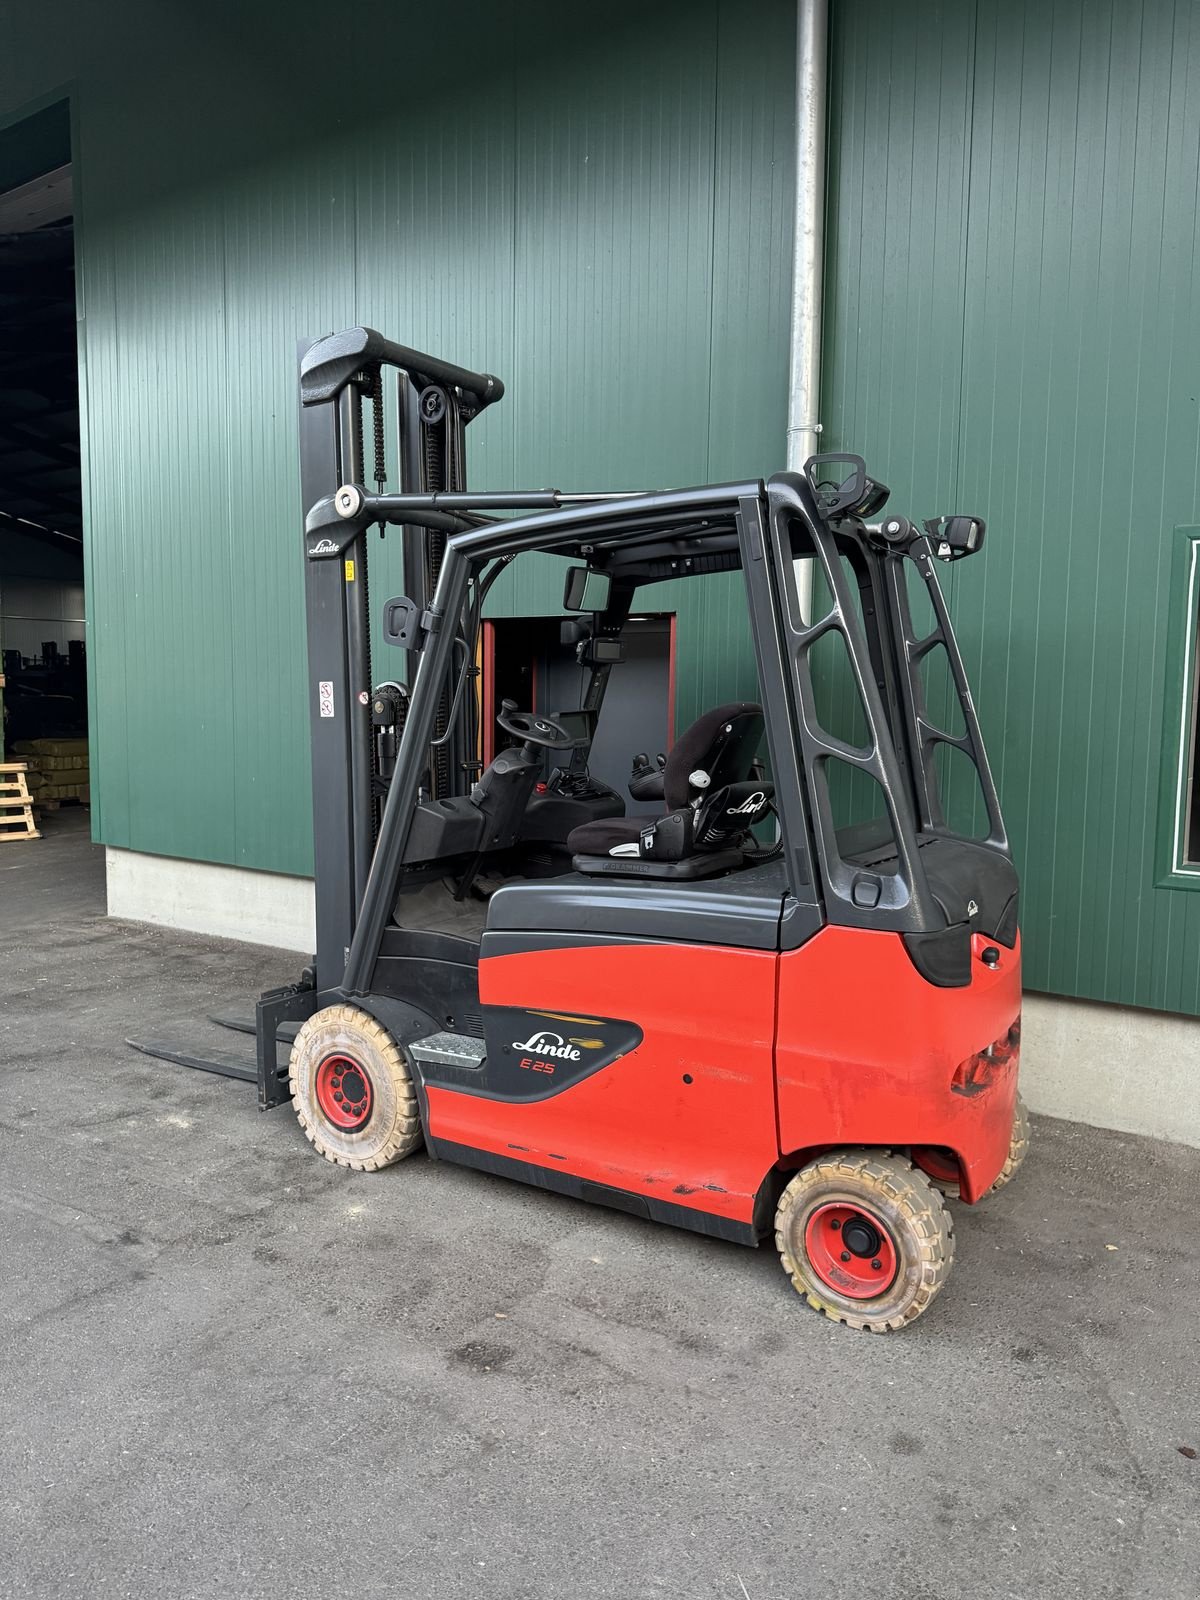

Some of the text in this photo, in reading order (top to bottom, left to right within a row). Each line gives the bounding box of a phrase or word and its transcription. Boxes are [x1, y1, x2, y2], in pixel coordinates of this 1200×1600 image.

[309, 539, 340, 554] Linde
[726, 791, 767, 815] Lind
[512, 1031, 581, 1061] Linde
